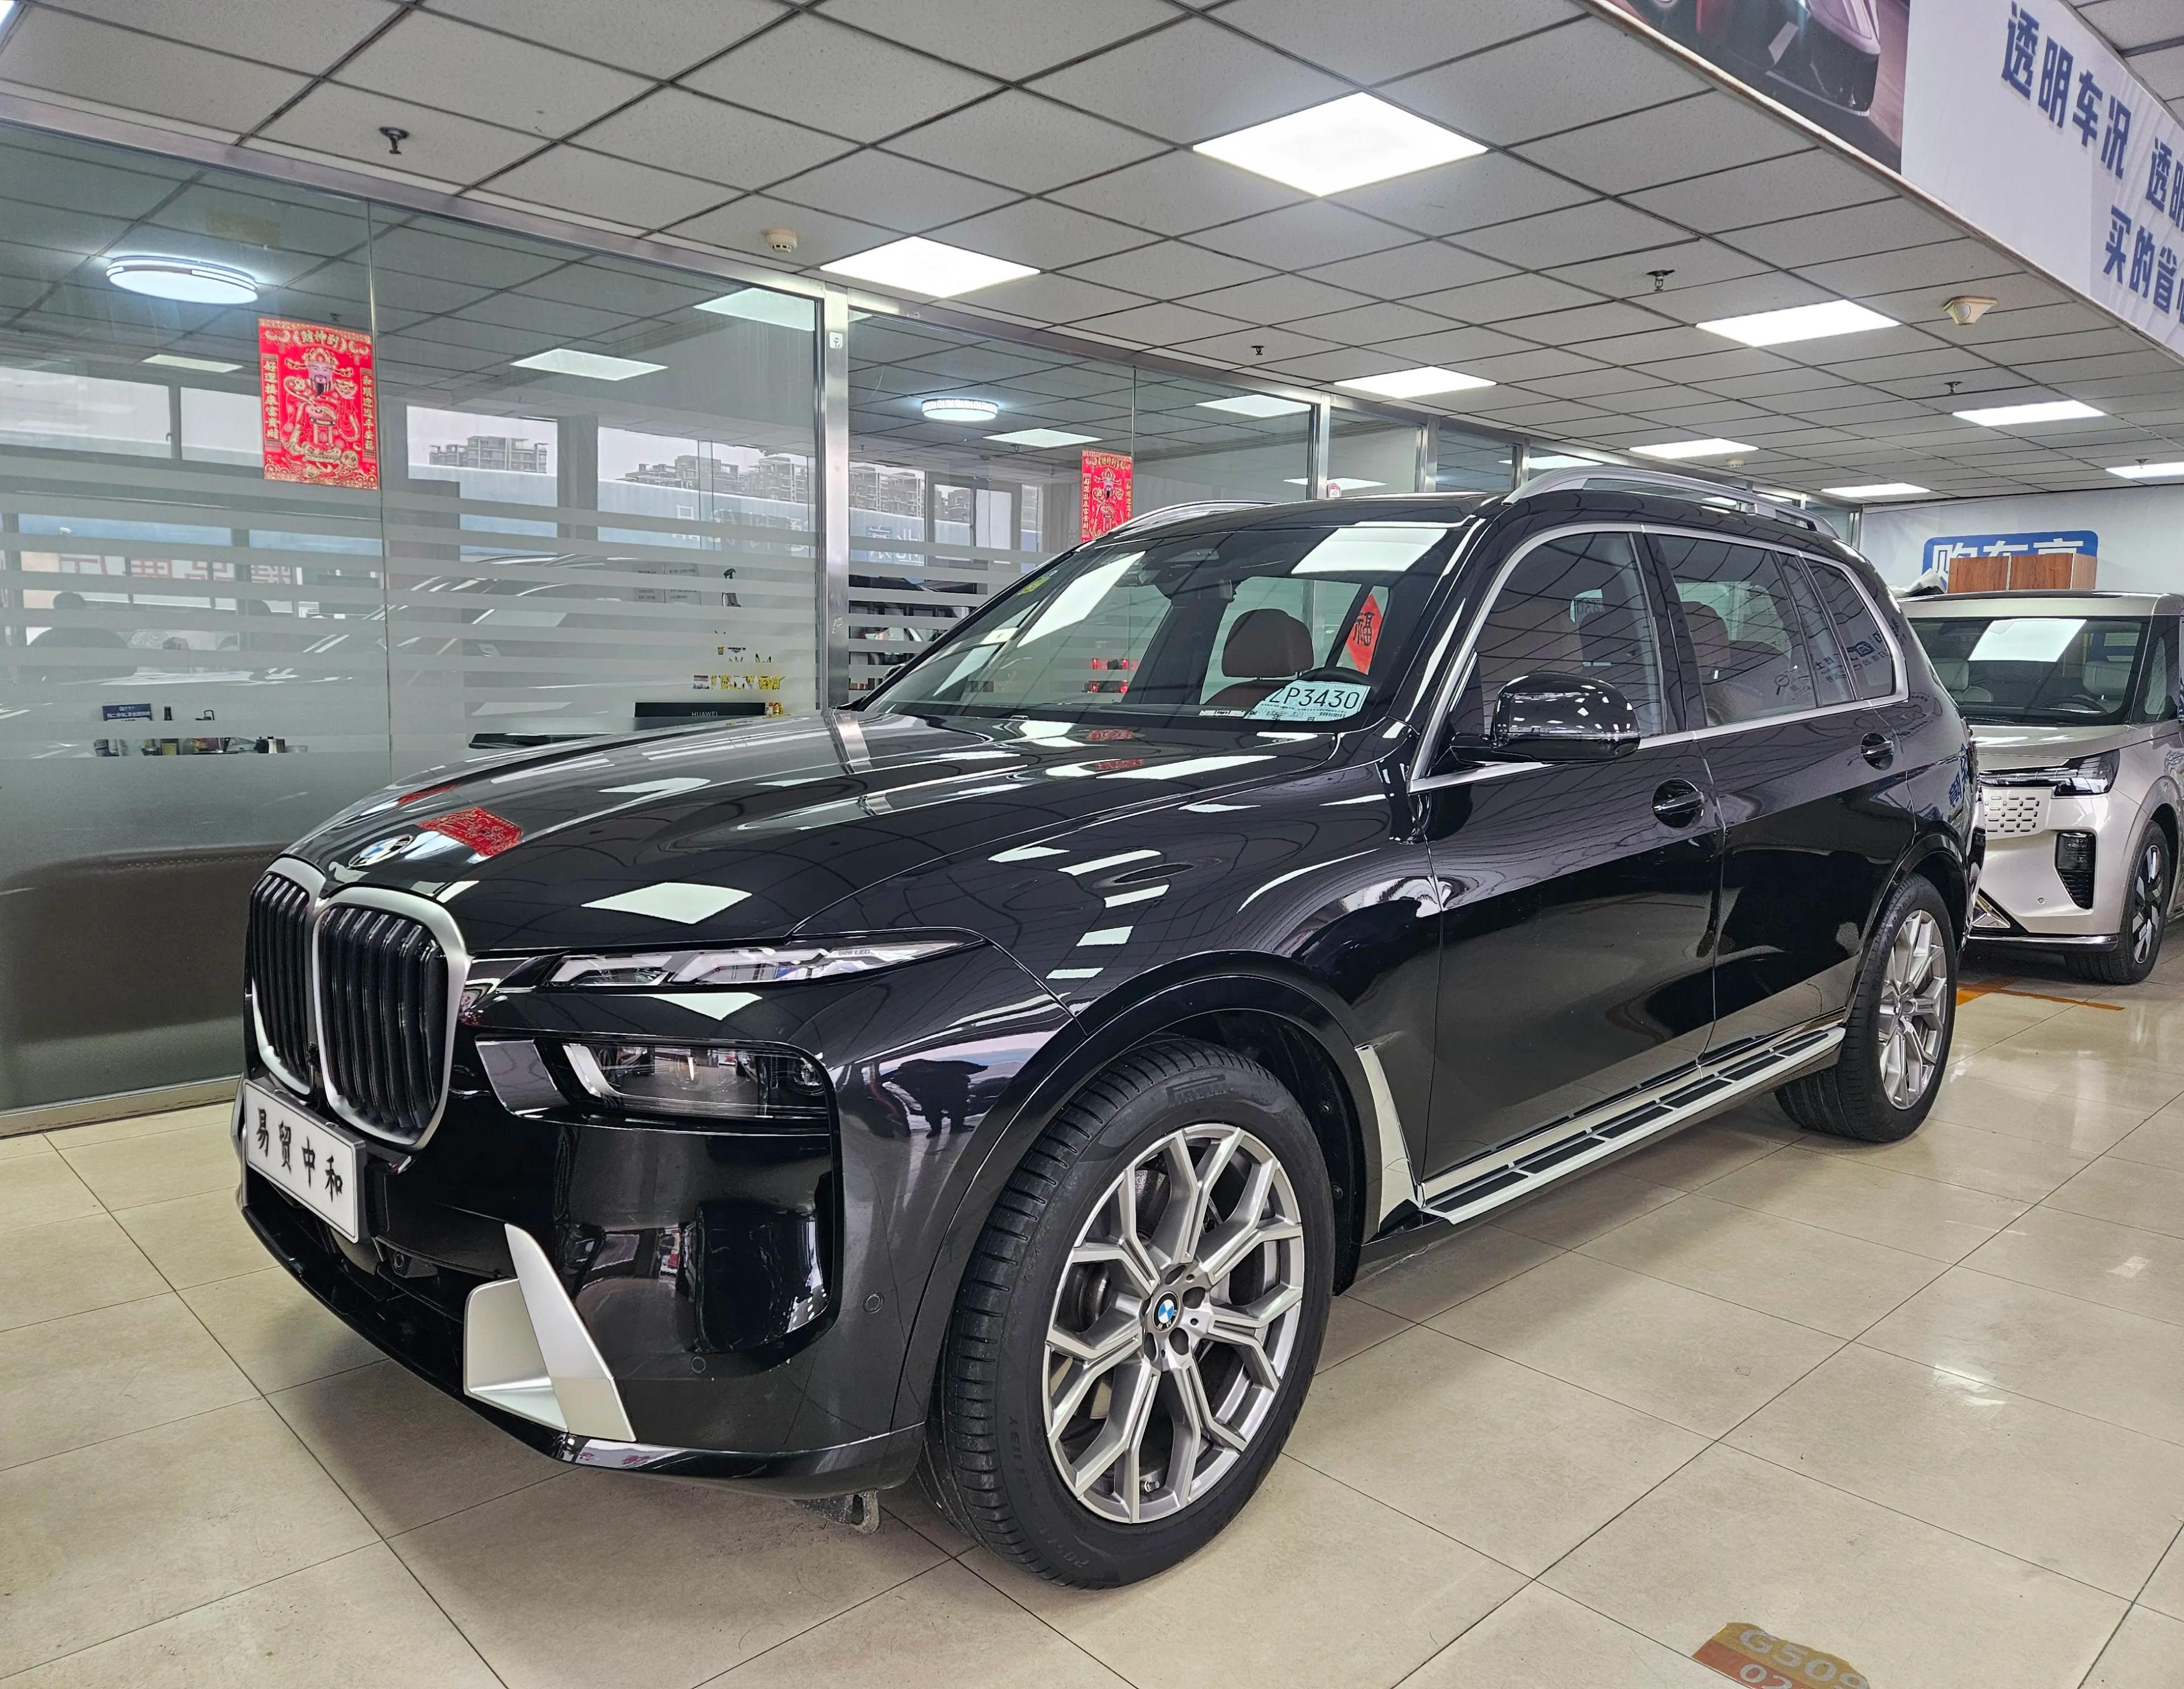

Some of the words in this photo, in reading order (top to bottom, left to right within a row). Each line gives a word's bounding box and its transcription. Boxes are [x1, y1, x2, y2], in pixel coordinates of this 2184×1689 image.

[2001, 0, 2132, 180] 透明车况
[1353, 612, 1375, 646] 福
